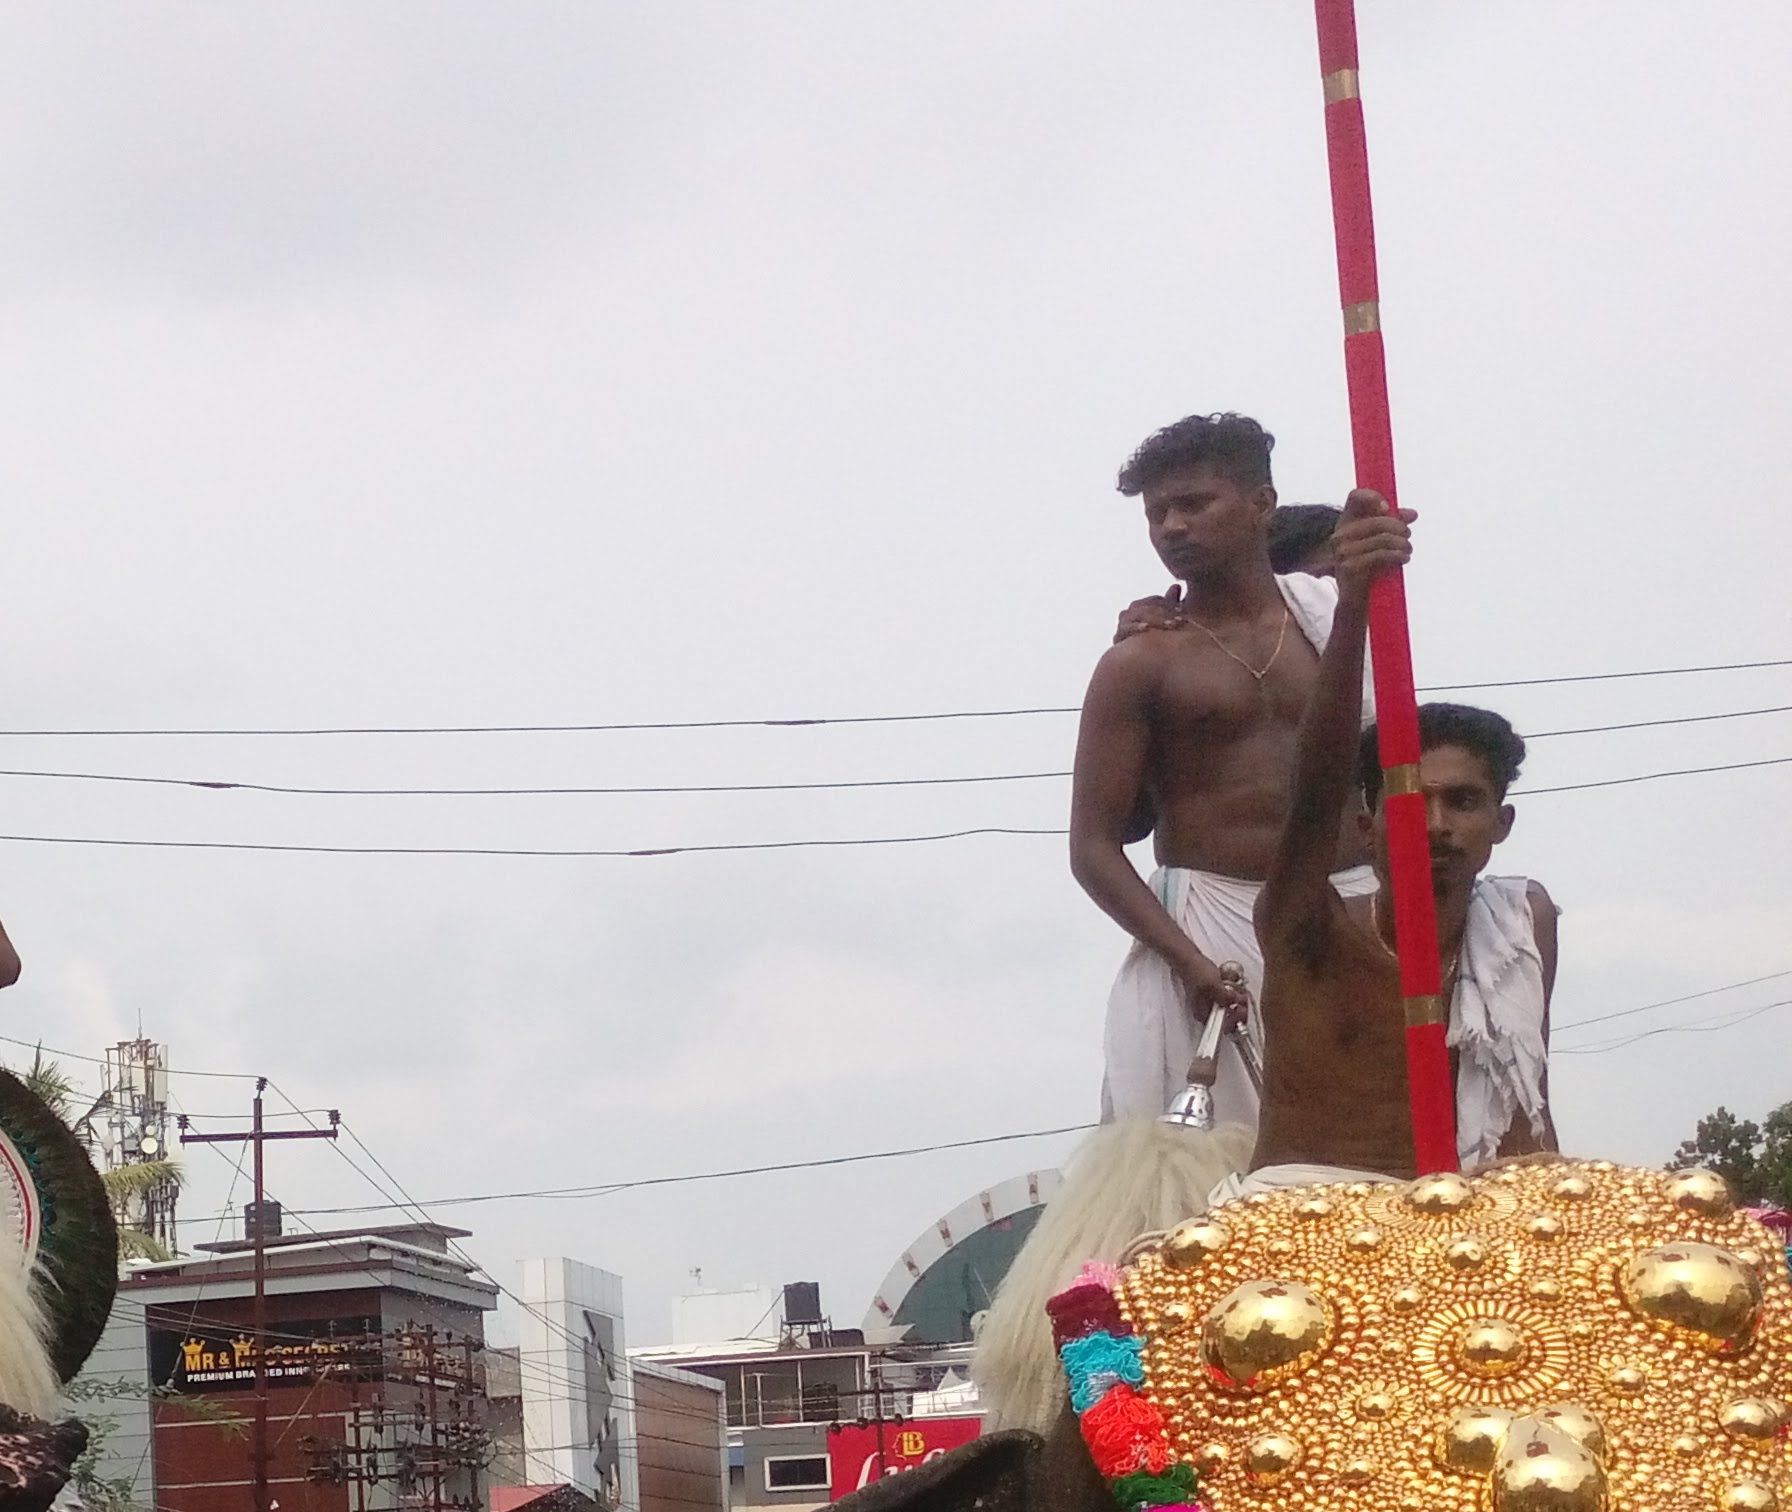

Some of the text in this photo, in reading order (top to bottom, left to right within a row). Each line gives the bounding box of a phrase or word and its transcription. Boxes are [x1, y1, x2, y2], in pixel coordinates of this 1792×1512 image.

[184, 1352, 215, 1371] MR
[219, 1351, 231, 1367] &
[187, 1371, 234, 1382] PREMIUM
